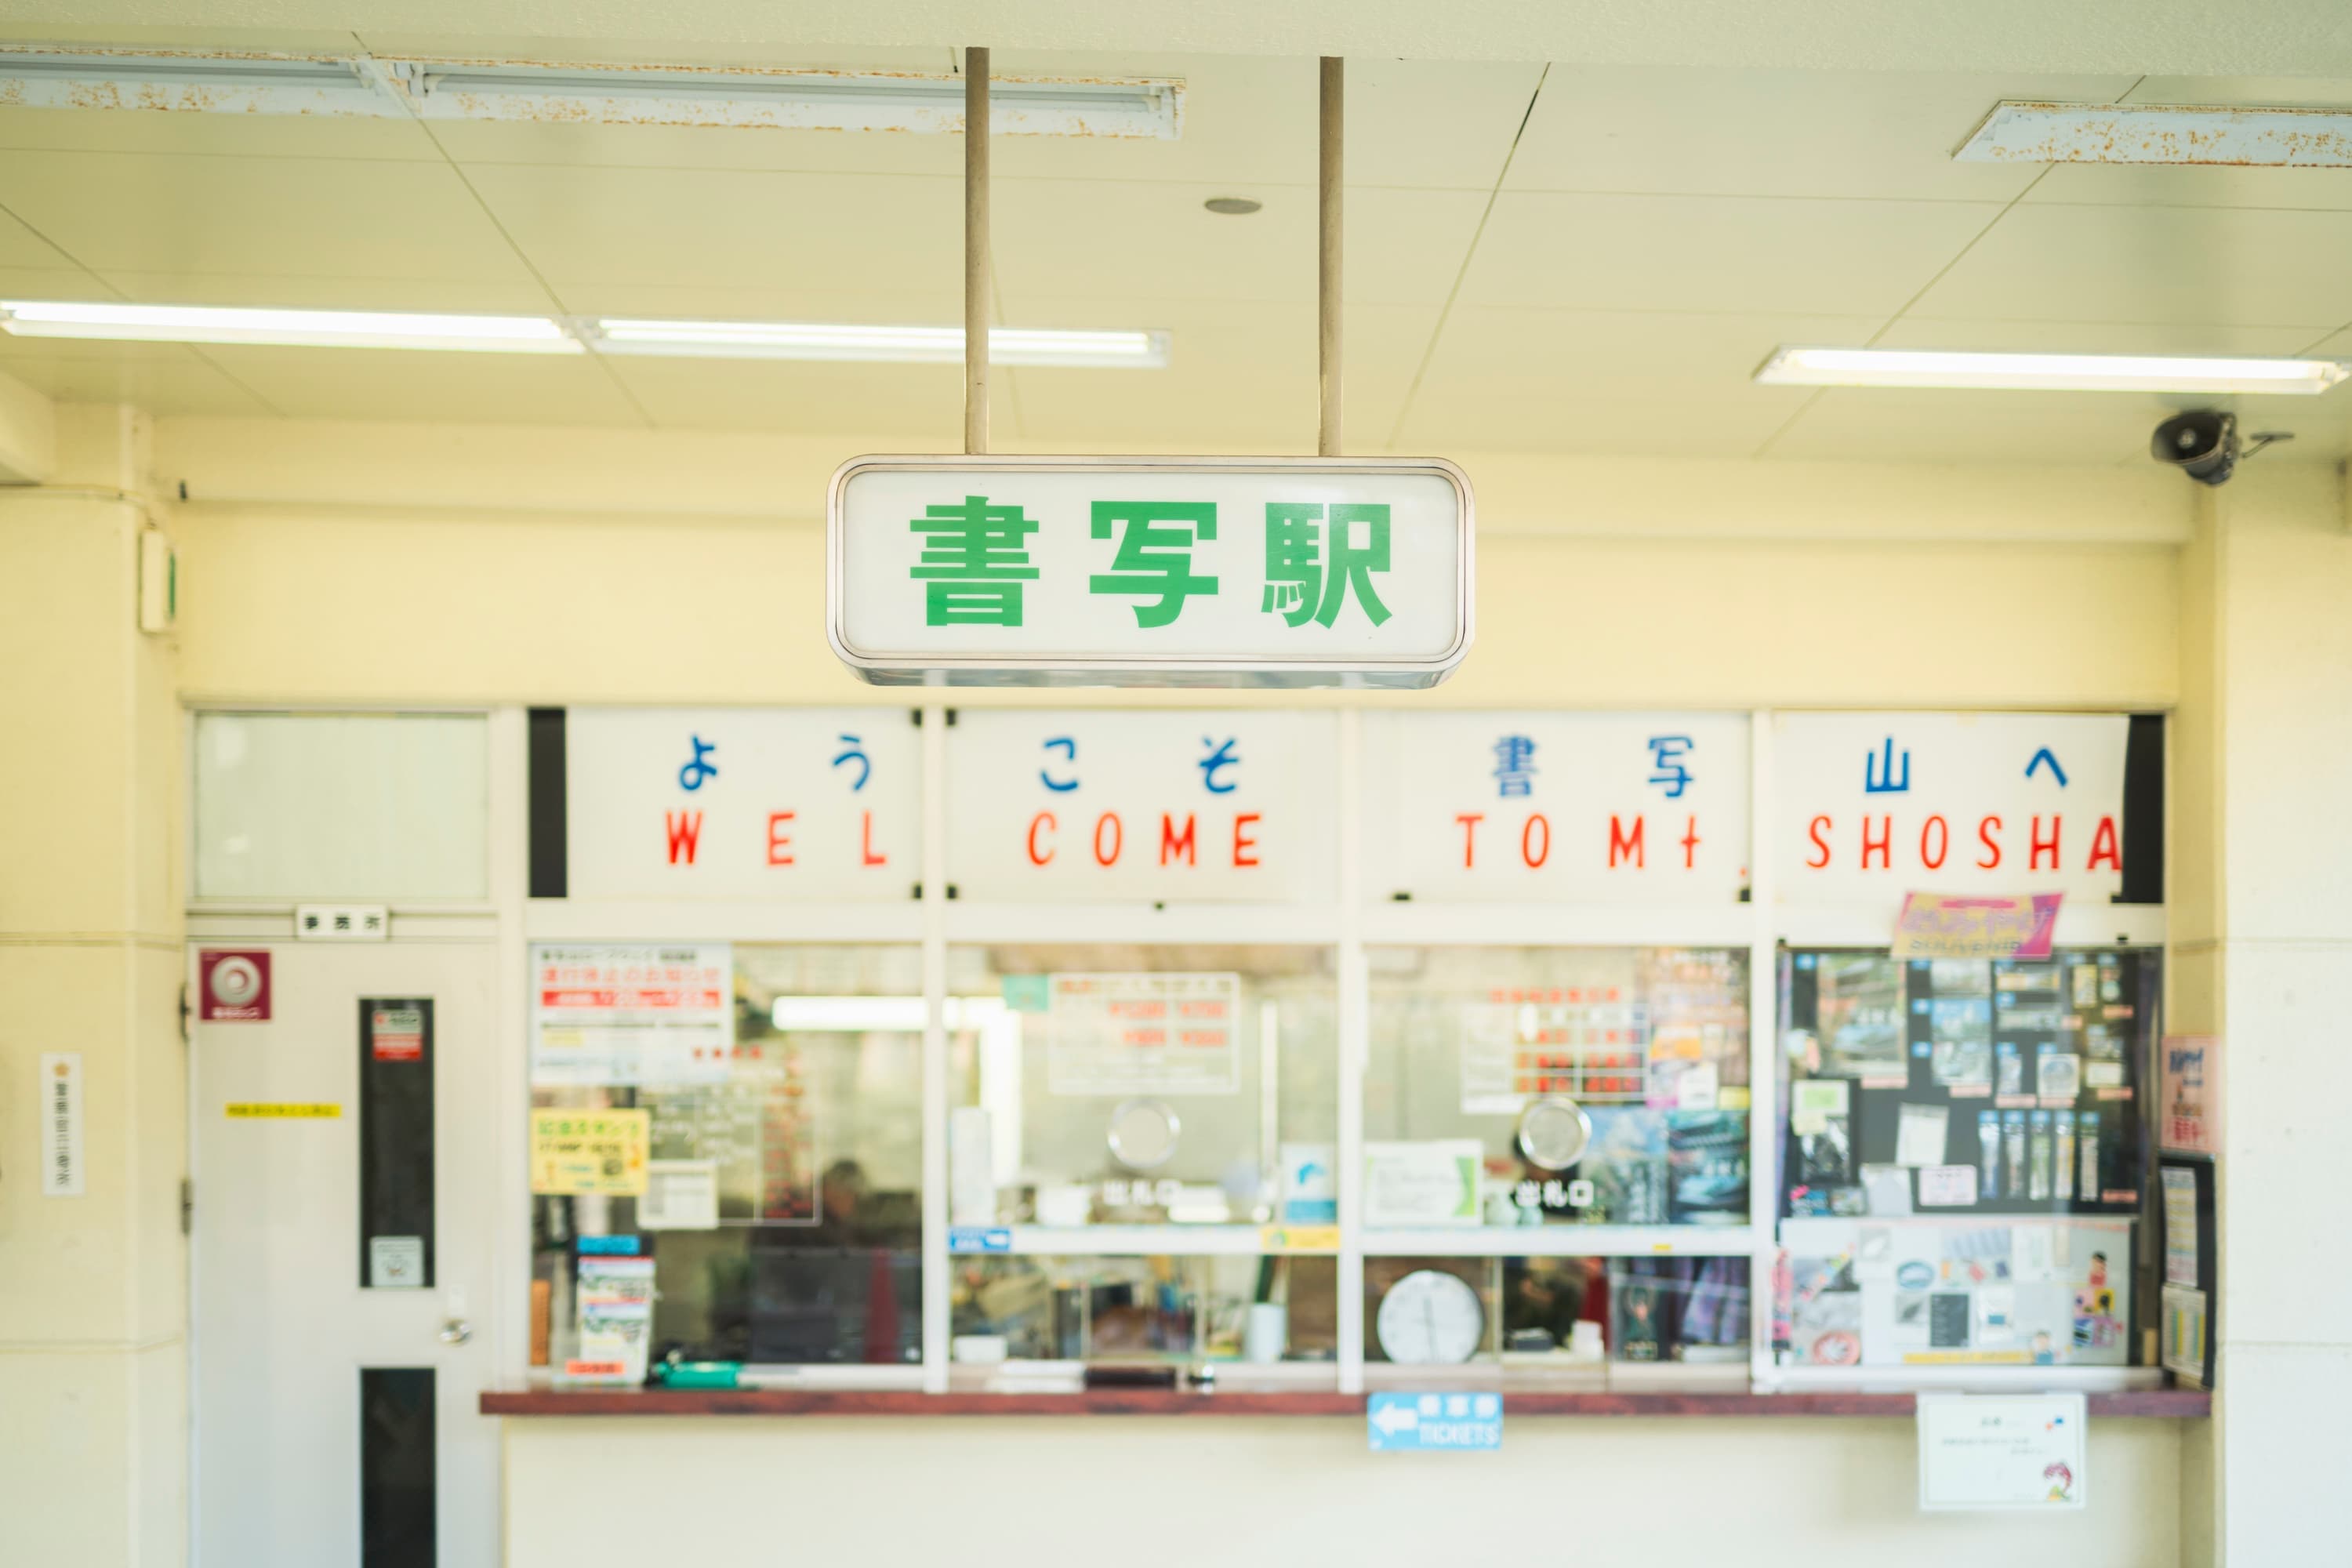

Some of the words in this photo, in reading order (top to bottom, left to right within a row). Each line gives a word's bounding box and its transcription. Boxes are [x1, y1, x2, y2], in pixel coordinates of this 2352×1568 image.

[909, 495, 1392, 630] 書写駅
[1456, 813, 1551, 869] TO
[1806, 814, 2123, 872] SHOSHA
[1419, 1421, 1500, 1446] TICKETS
